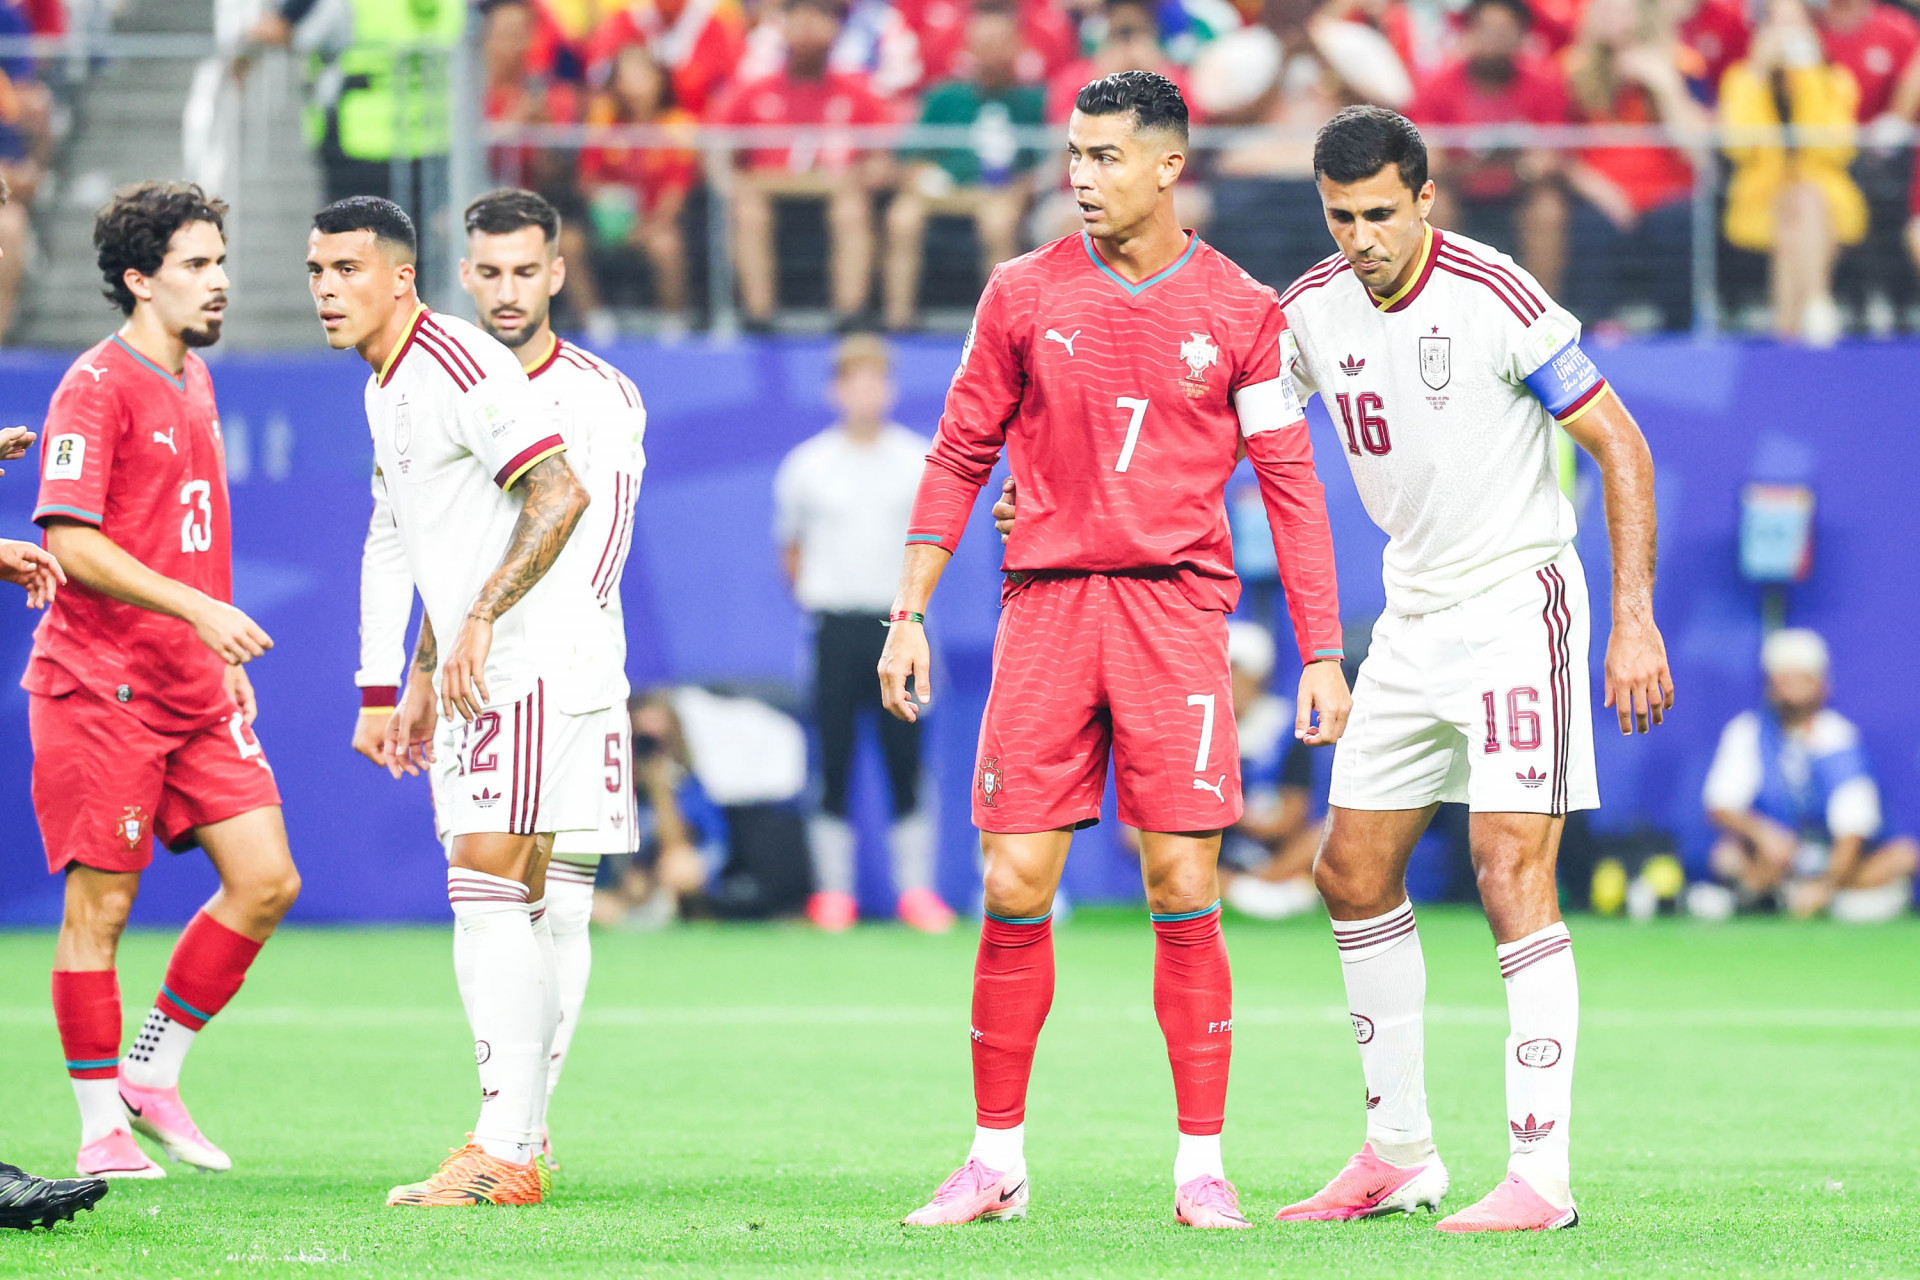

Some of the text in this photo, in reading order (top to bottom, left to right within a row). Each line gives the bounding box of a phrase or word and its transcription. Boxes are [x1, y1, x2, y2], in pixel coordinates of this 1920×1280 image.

[1114, 396, 1149, 472] 7
[1335, 391, 1392, 456] 16
[180, 479, 212, 553] 23
[1187, 693, 1215, 772] 7
[1482, 686, 1542, 754] 16
[604, 733, 621, 793] 5
